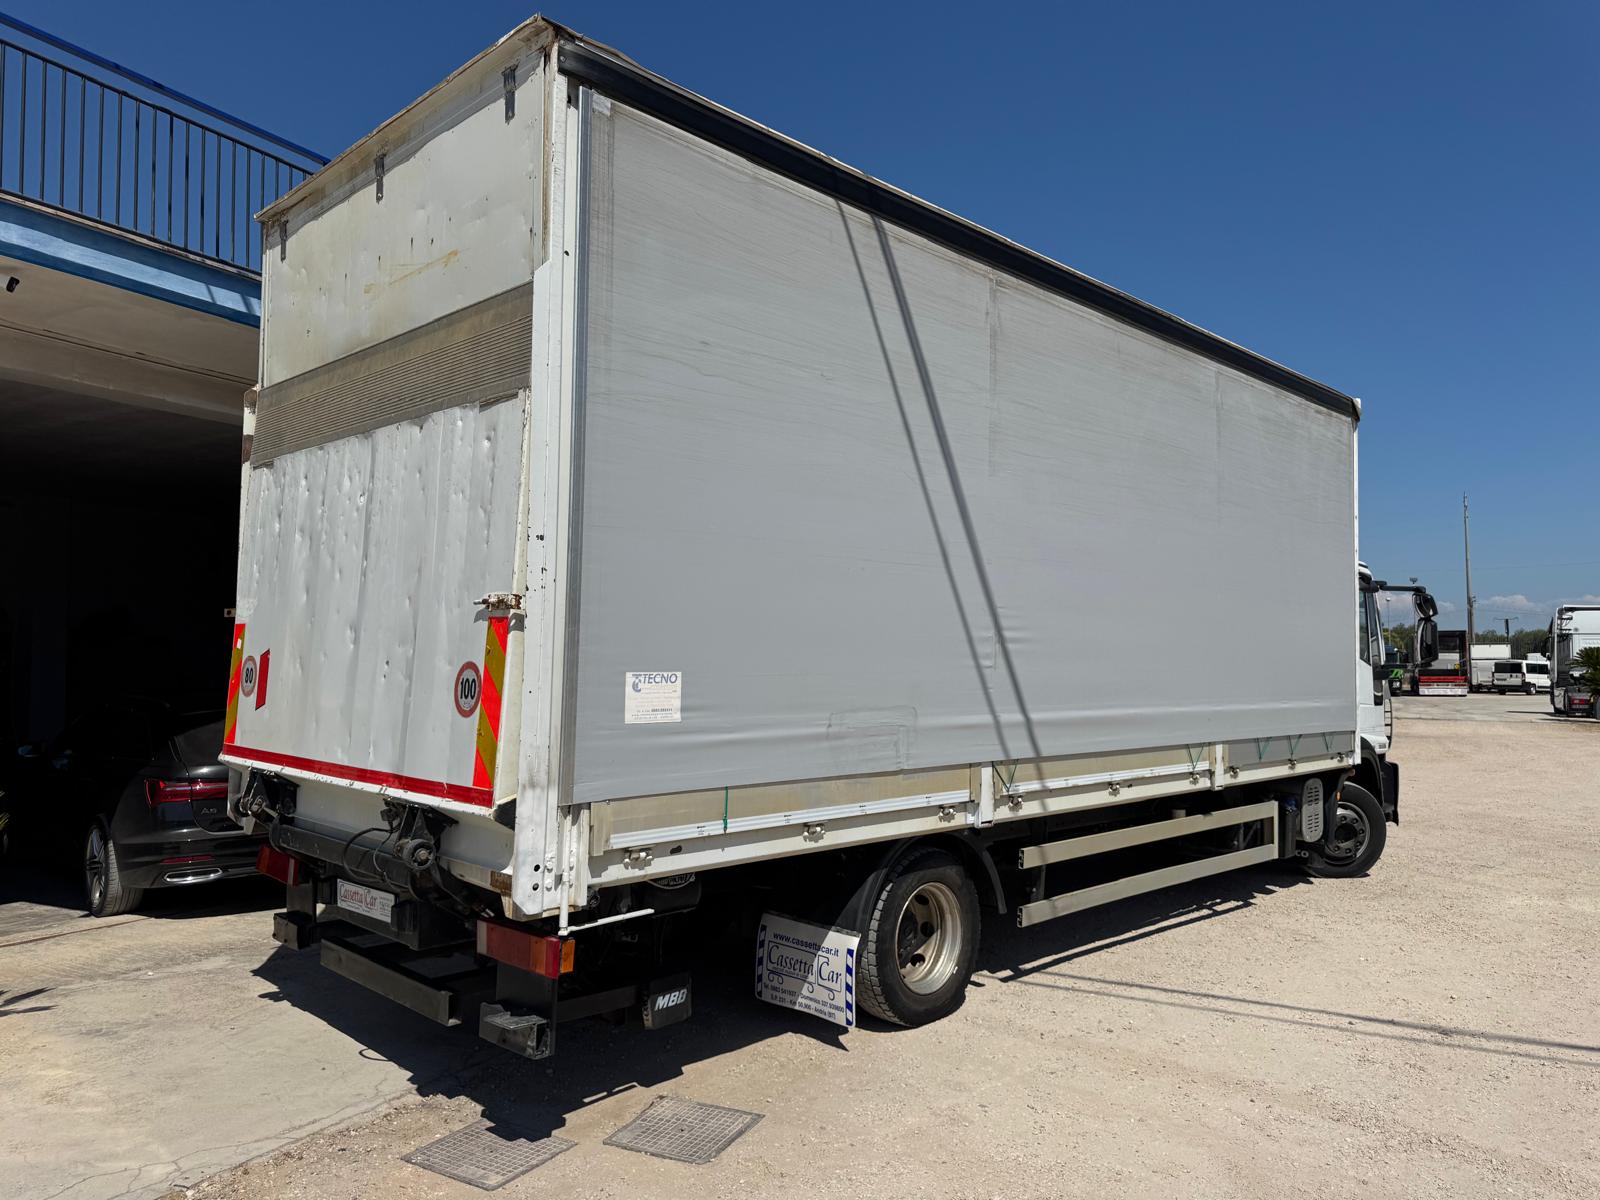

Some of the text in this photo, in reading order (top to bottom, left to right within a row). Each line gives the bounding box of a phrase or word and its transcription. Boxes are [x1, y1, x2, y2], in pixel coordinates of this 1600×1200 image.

[244, 667, 254, 684] 80
[642, 673, 678, 684] TECNO
[460, 677, 477, 700] 100
[768, 944, 814, 976] Cassetta
[818, 961, 842, 984] Car
